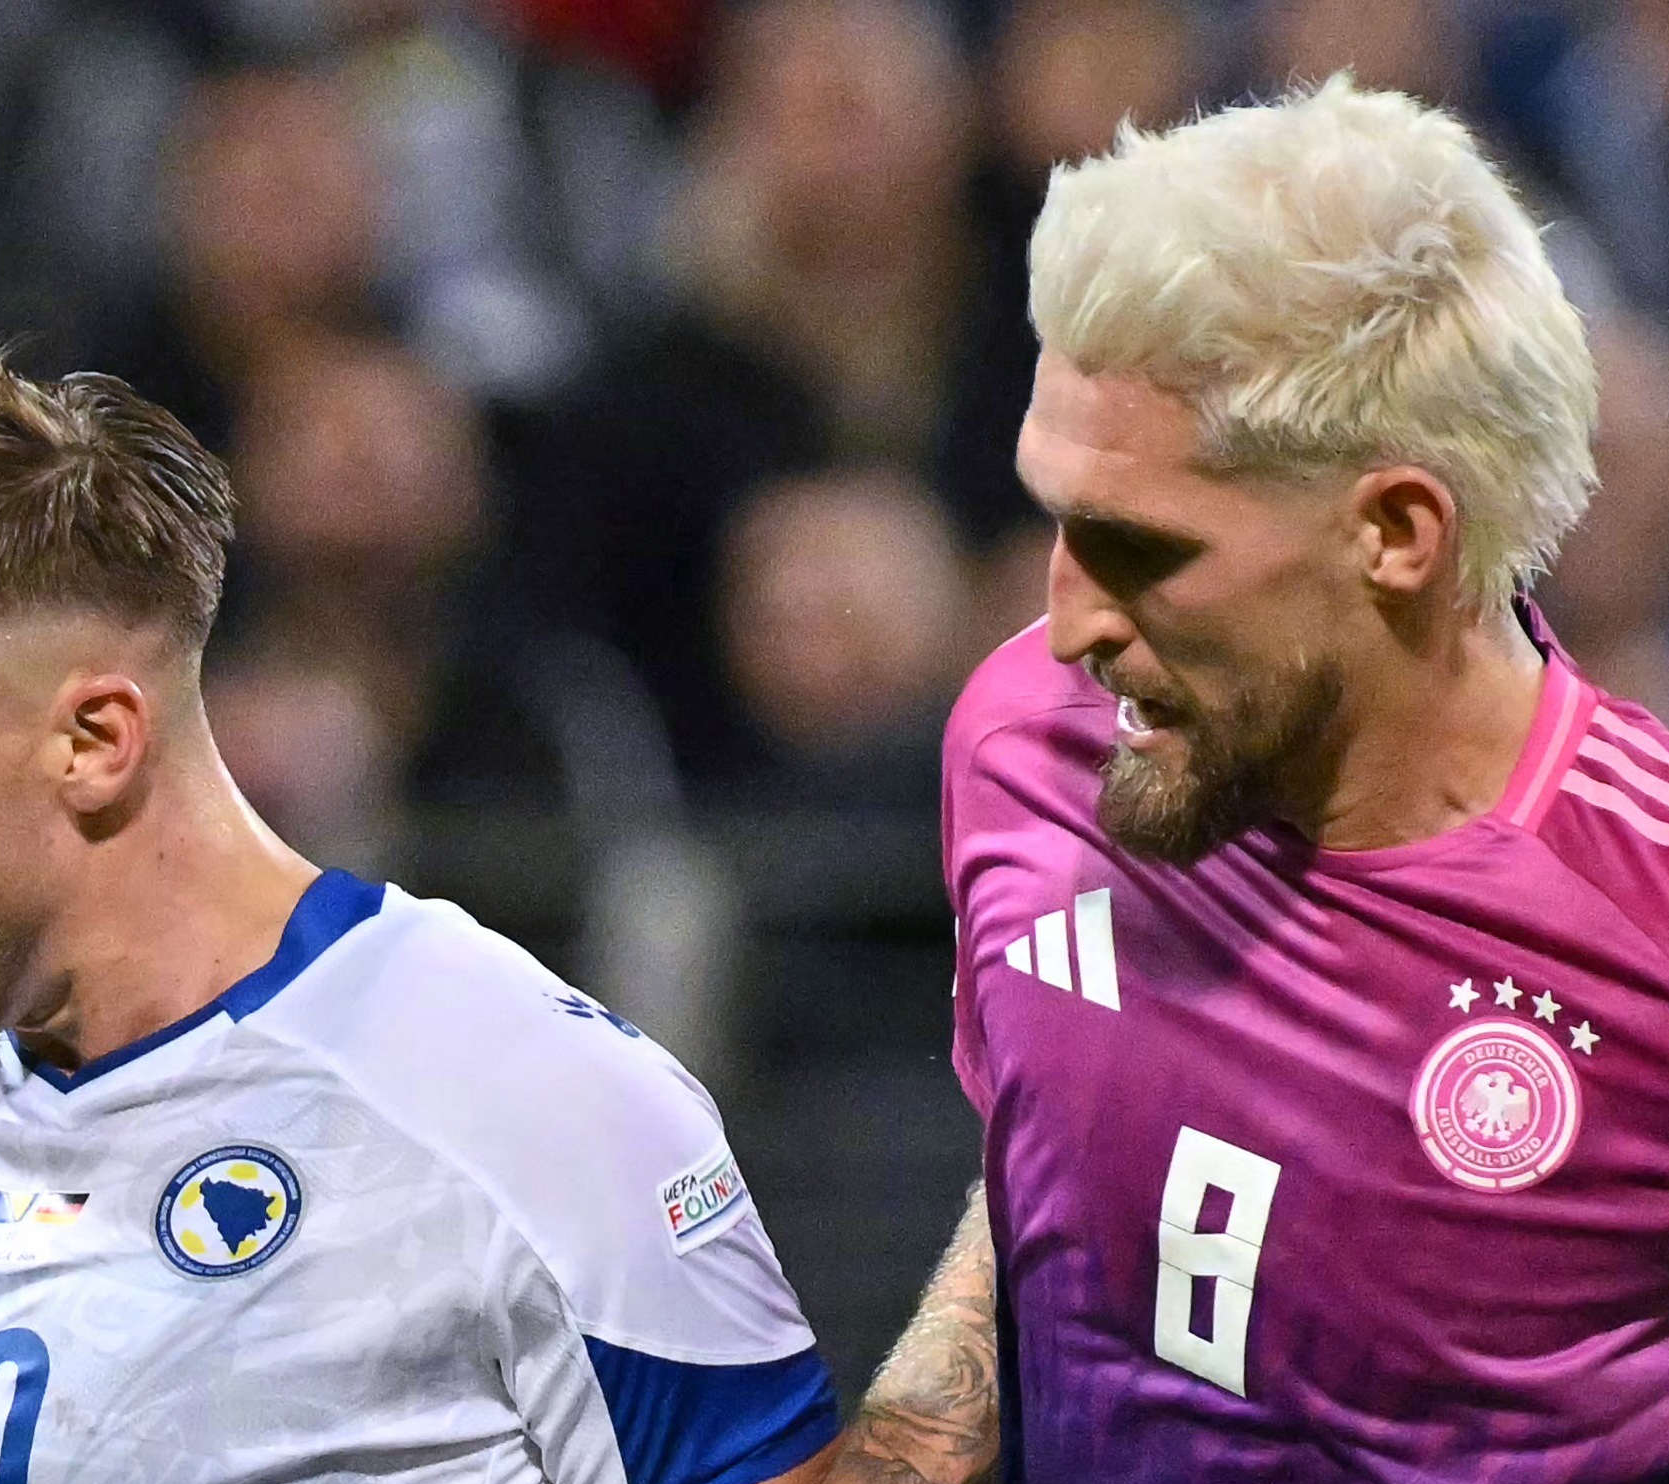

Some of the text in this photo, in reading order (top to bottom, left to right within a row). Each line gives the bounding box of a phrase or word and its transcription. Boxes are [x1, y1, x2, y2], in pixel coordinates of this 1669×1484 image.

[1464, 1044, 1549, 1090] DEUTSCHER
[1436, 1107, 1542, 1167] FUSSBALL-BUND
[663, 1174, 698, 1203] UEFA
[1154, 1126, 1280, 1399] 8
